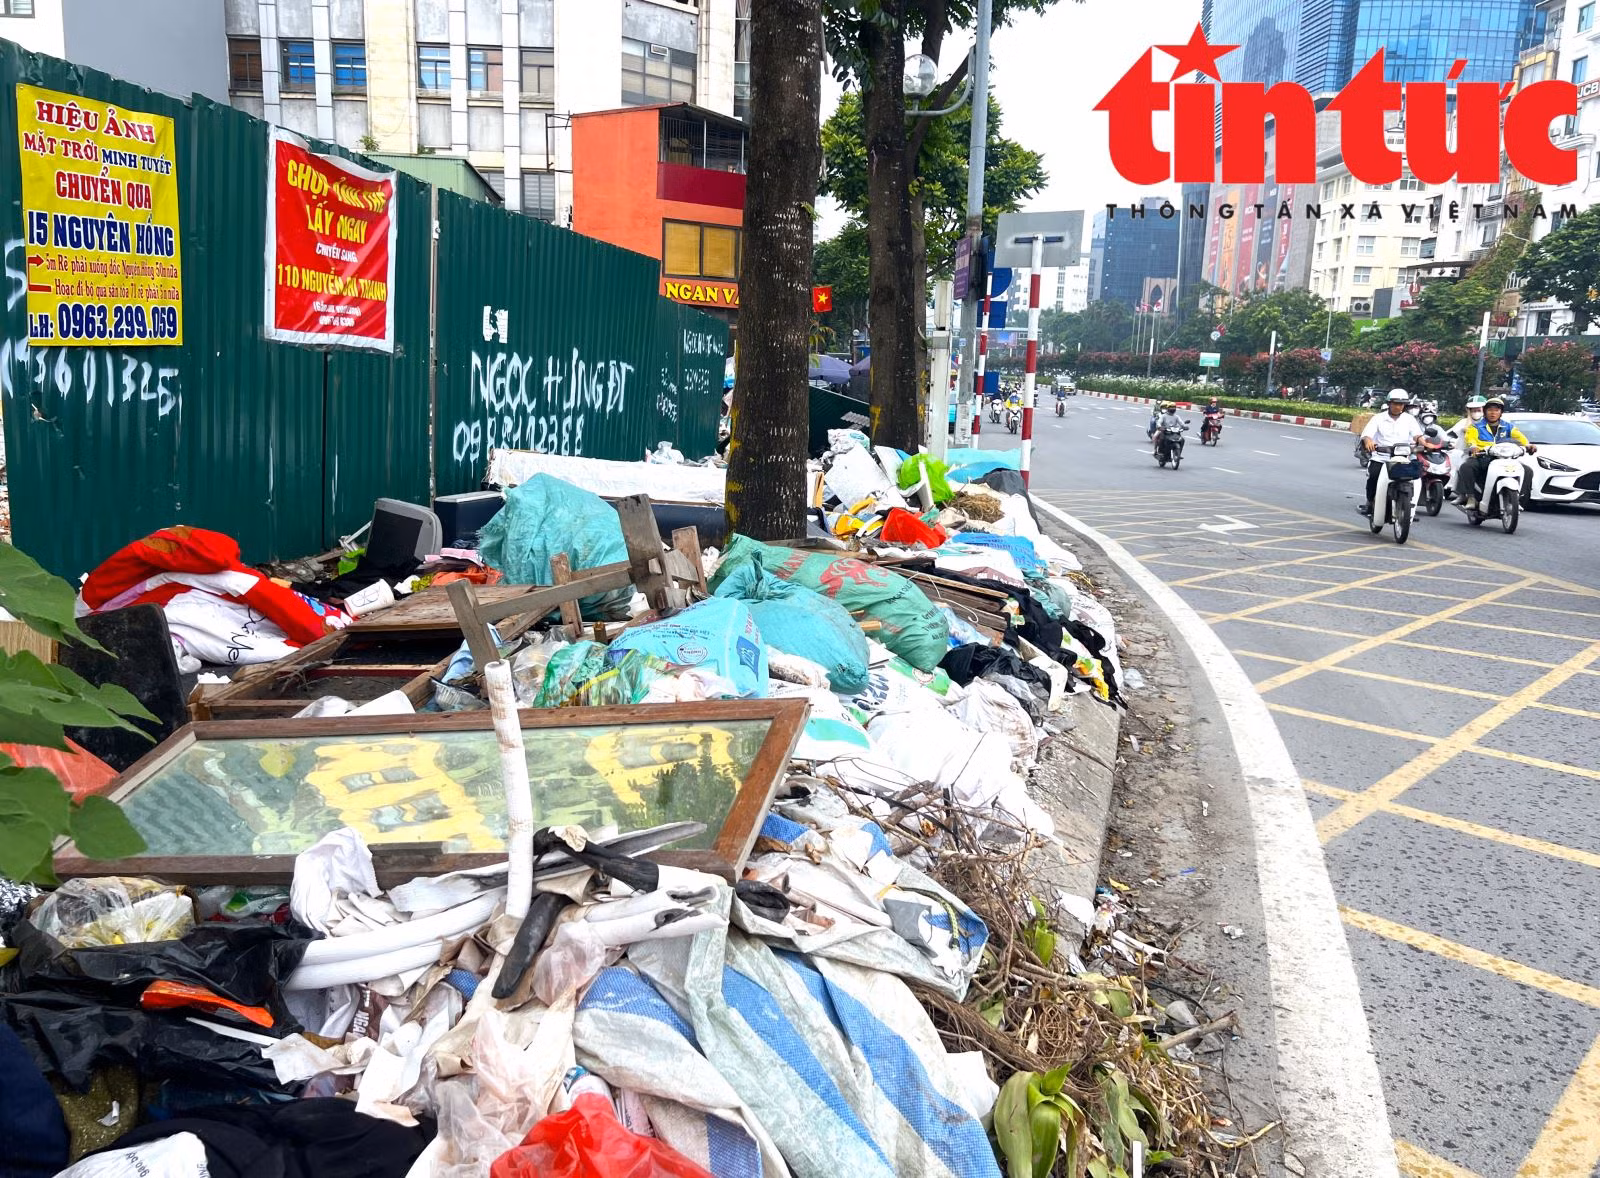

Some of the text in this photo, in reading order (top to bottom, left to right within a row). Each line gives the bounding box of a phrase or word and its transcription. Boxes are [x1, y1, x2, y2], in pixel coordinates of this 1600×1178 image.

[36, 101, 156, 143] HIỆU ẢNH
[23, 131, 172, 175] MẶT TRỜI MINH TUYẾT
[56, 166, 153, 209] CHUYỂN QUA
[28, 211, 48, 245] 15
[53, 212, 131, 253] NGUYÊN
[306, 201, 368, 244] LẤY NGAY
[71, 254, 87, 275] phải
[278, 263, 300, 288] 110
[665, 282, 719, 302] NGAN
[58, 303, 178, 339] 0963.299.059
